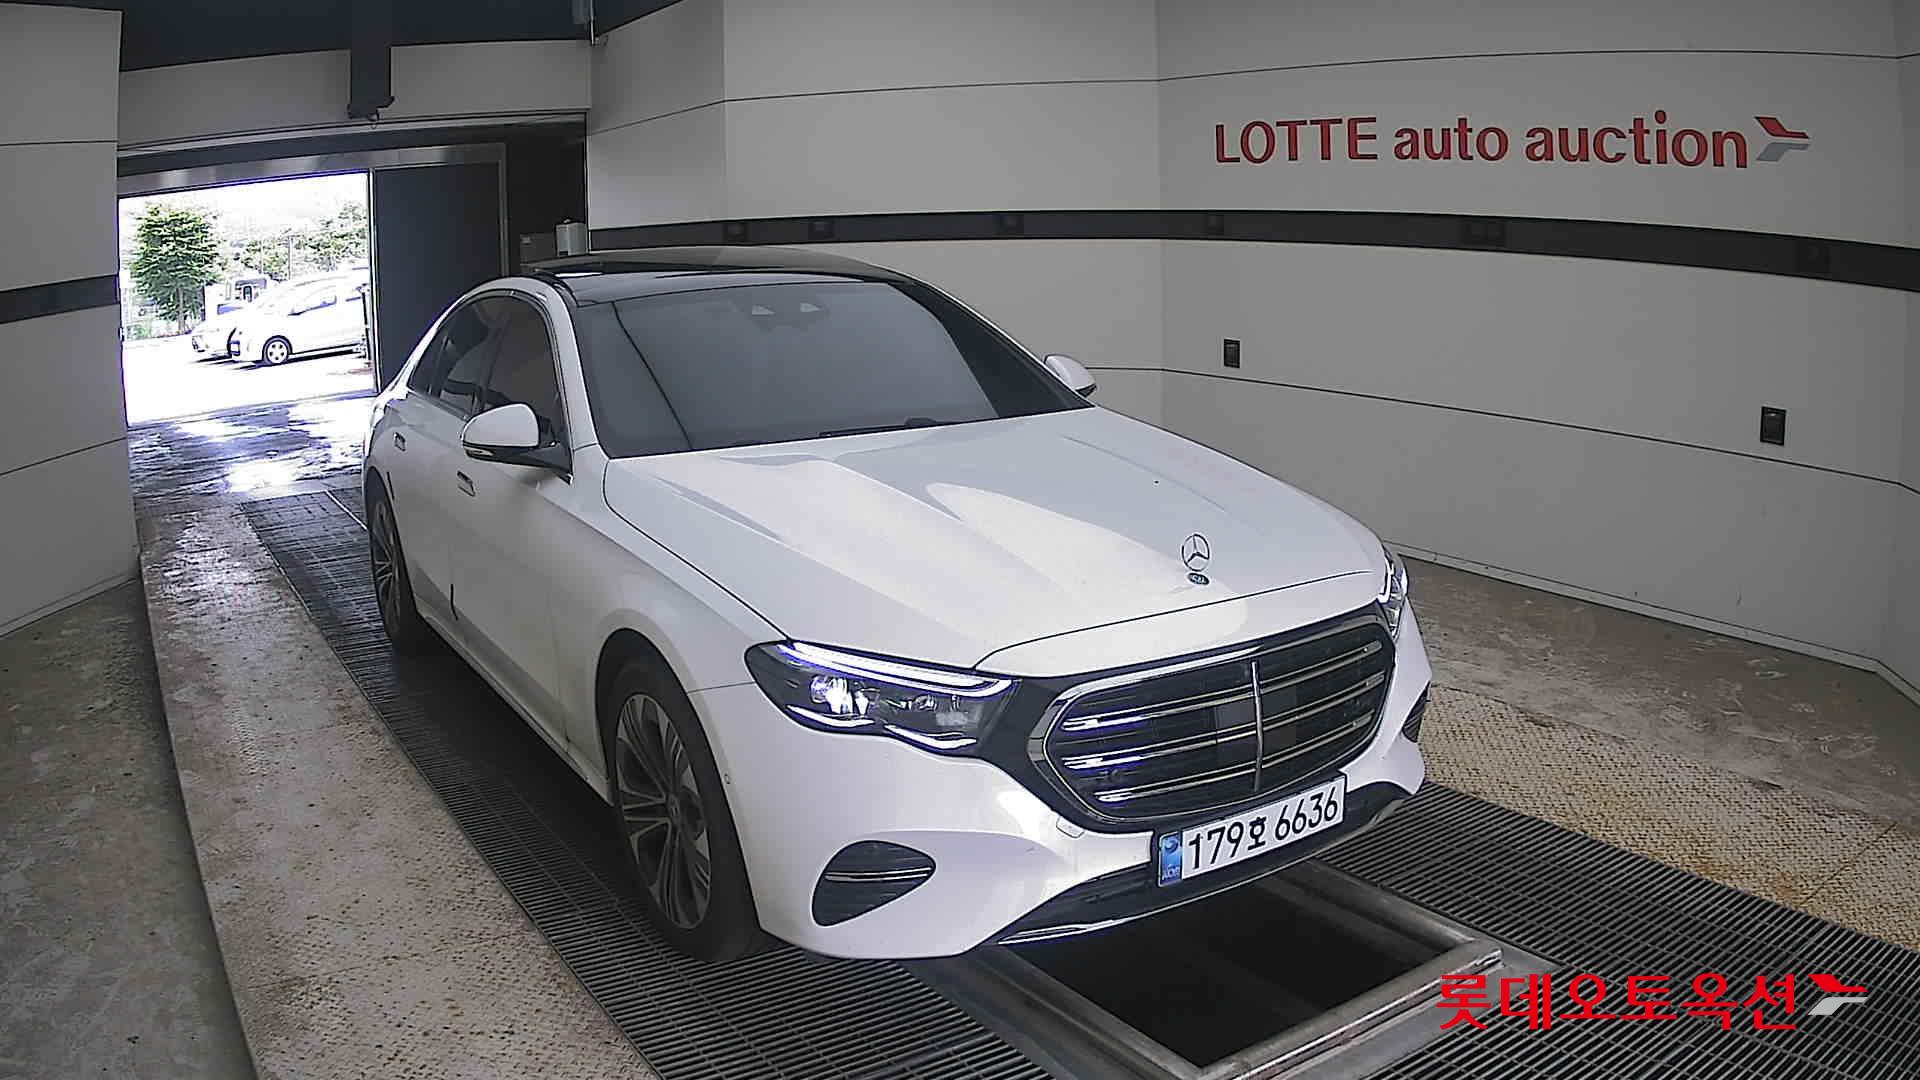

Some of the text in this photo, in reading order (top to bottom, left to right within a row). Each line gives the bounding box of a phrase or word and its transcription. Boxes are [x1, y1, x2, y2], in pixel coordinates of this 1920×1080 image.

[1215, 110, 1748, 168] LOTTE auto auction
[1188, 786, 1338, 870] 179호 6636
